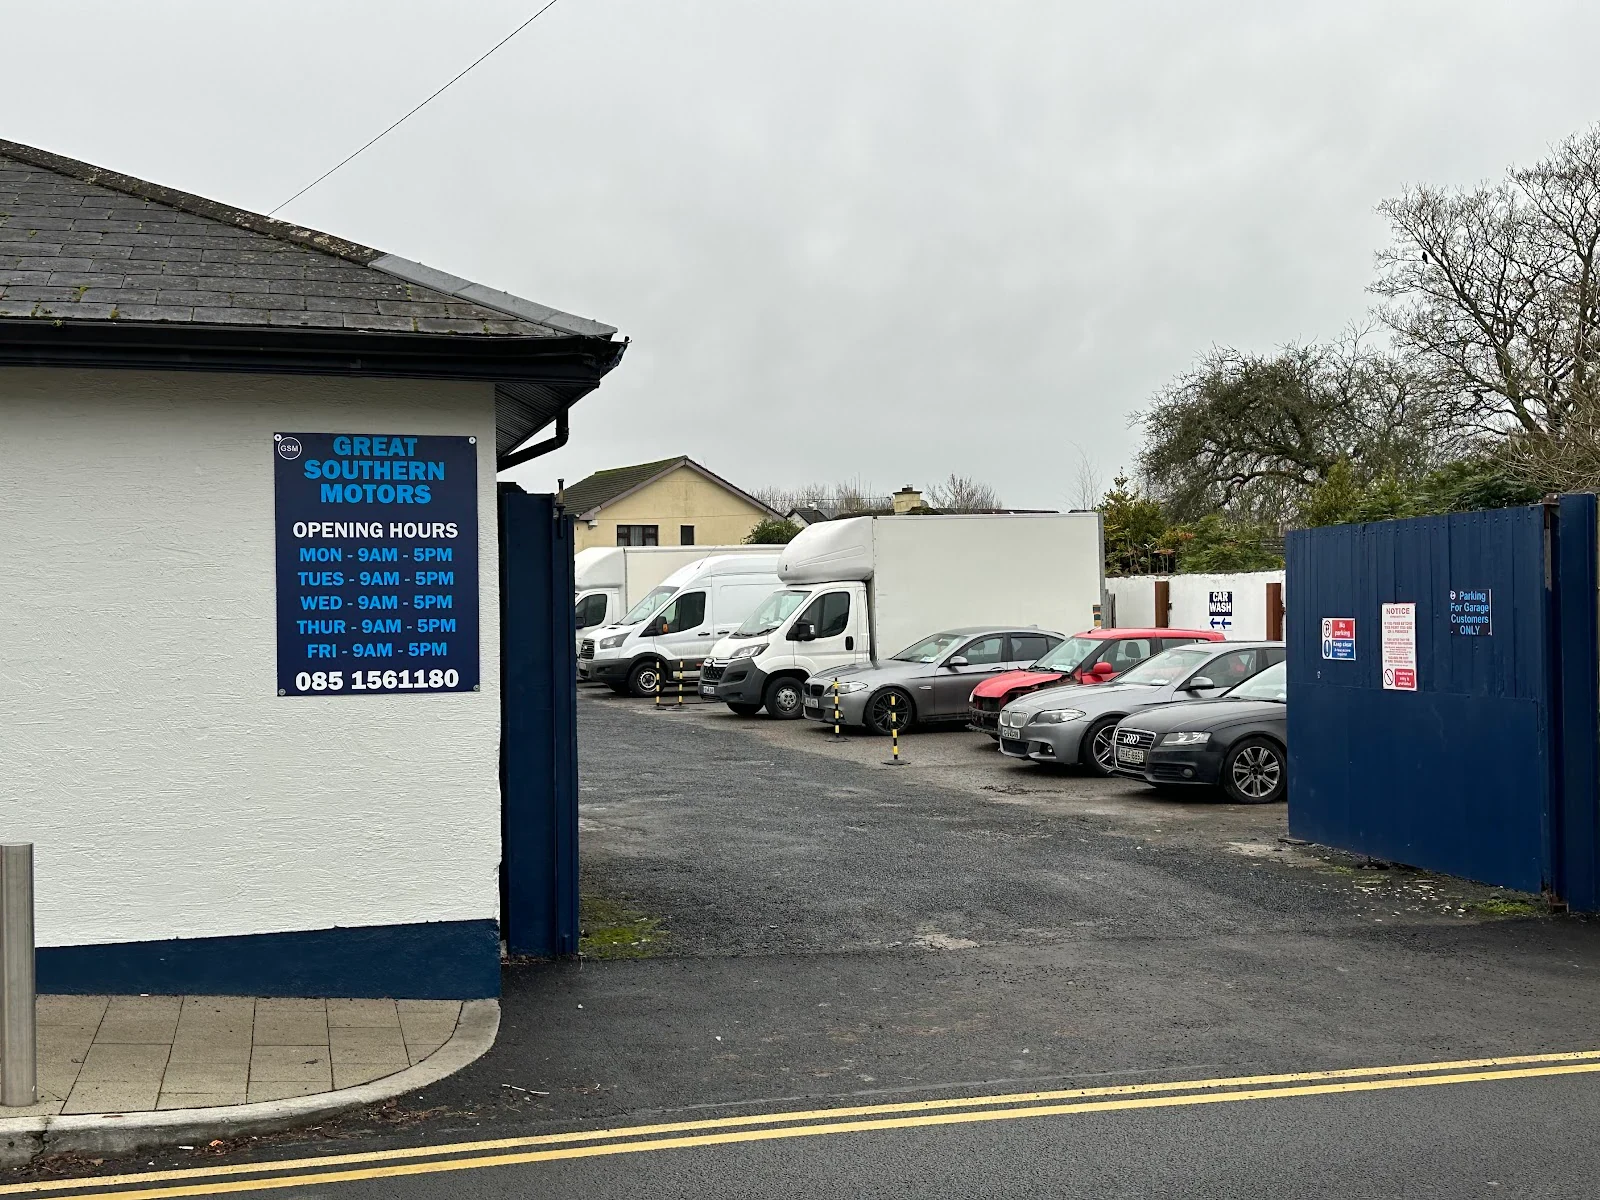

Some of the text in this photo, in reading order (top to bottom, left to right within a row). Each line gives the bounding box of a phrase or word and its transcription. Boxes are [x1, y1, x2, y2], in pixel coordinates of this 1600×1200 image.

[333, 437, 417, 456] GREAT
[304, 460, 444, 480] SOUTHERN
[321, 484, 431, 504] MOTORS
[293, 522, 458, 538] OPENING HOURS
[300, 548, 341, 562] MON
[358, 548, 397, 562] 9AM
[414, 548, 452, 561] 5PM
[298, 572, 344, 586] TUES
[360, 572, 399, 586] 9AM
[415, 572, 454, 585] 5PM
[300, 596, 342, 610] WED
[358, 595, 397, 609] 9AM
[414, 595, 452, 609] 5PM
[1213, 592, 1228, 601] CAR
[1460, 591, 1486, 602] Parking
[1210, 602, 1231, 612] WASH
[1386, 607, 1410, 615] NOTICE
[1451, 603, 1489, 614] For Garage
[1451, 614, 1489, 623] Customers
[297, 620, 345, 634] THUR
[362, 619, 401, 633] 9AM
[418, 619, 456, 632] 5PM
[1460, 625, 1480, 635] ONLY
[1335, 630, 1351, 638] parking
[308, 644, 336, 658] FRI
[353, 643, 392, 657] 9AM
[408, 642, 447, 656] 5PM
[296, 669, 459, 691] 085 1561180
